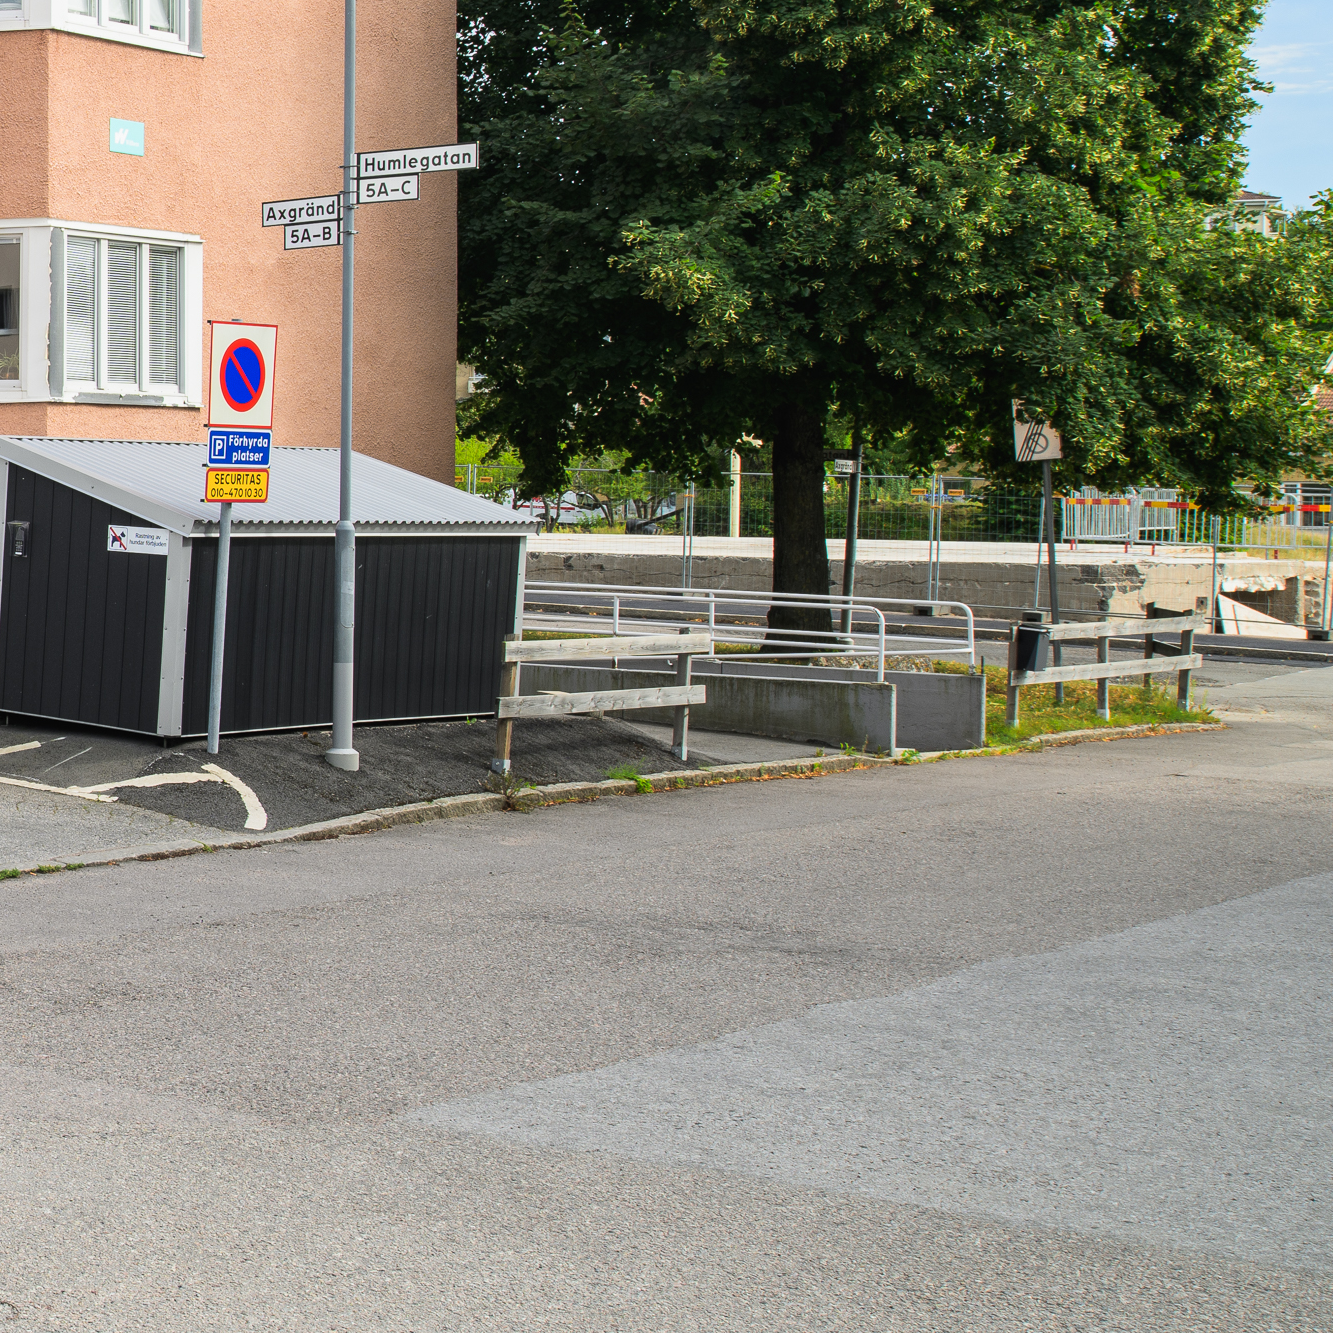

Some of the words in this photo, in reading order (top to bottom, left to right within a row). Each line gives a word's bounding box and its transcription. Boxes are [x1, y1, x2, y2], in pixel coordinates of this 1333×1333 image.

[364, 150, 472, 172] Humlegatan
[365, 180, 411, 198] 5A-C
[265, 200, 335, 222] Axgränd
[290, 226, 332, 244] 5A-B
[215, 439, 223, 455] P
[228, 435, 269, 449] Förhyrda
[232, 449, 264, 463] platser
[214, 473, 262, 485] SECURITAS
